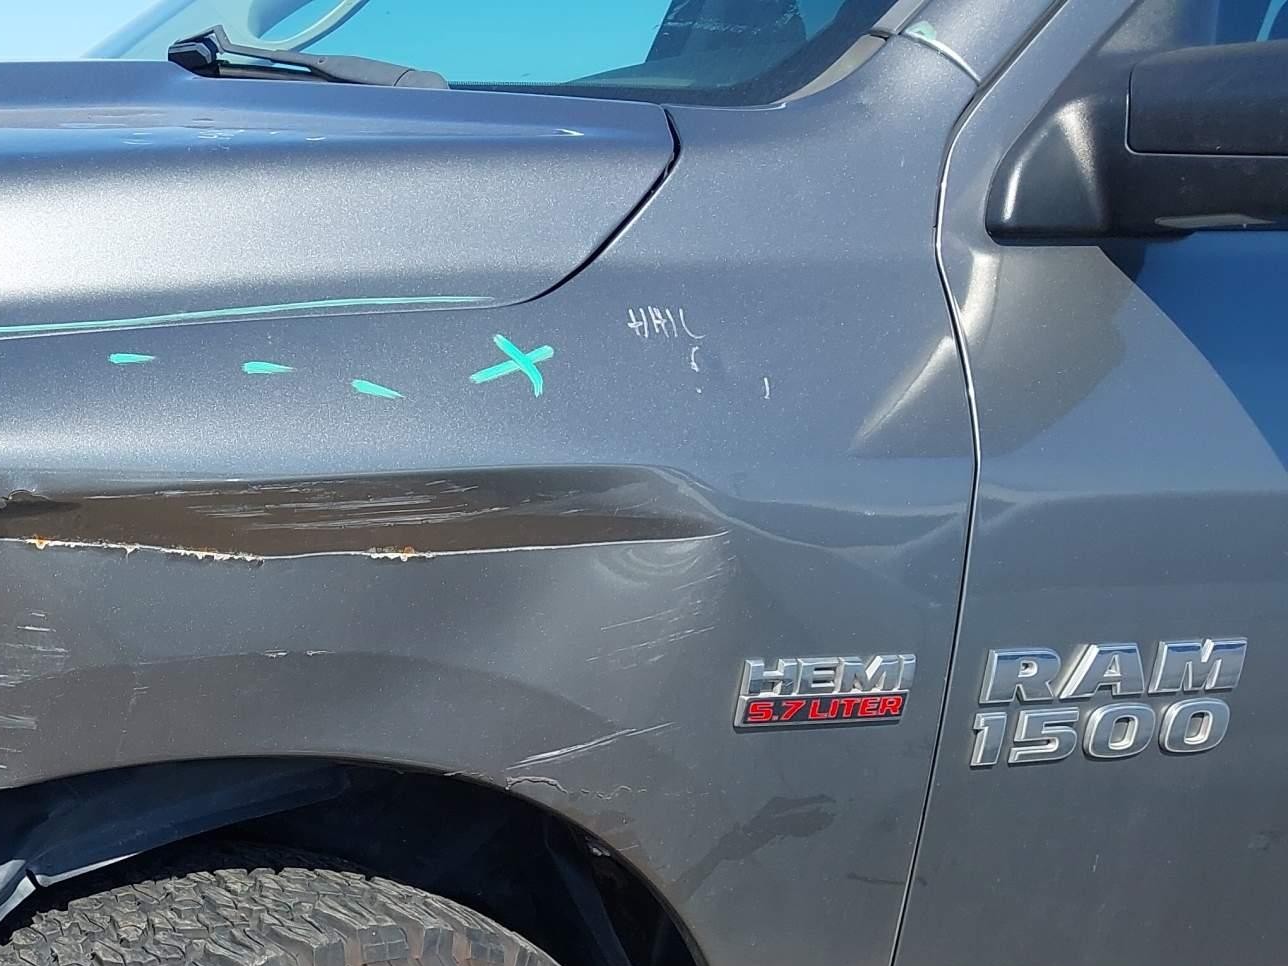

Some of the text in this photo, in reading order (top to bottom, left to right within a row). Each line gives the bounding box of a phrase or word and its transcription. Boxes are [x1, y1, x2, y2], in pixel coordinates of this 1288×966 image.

[743, 653, 917, 697] HEMI
[978, 637, 1248, 705] RAM
[748, 697, 903, 722] 5.7 LITER
[969, 698, 1232, 768] 1500
